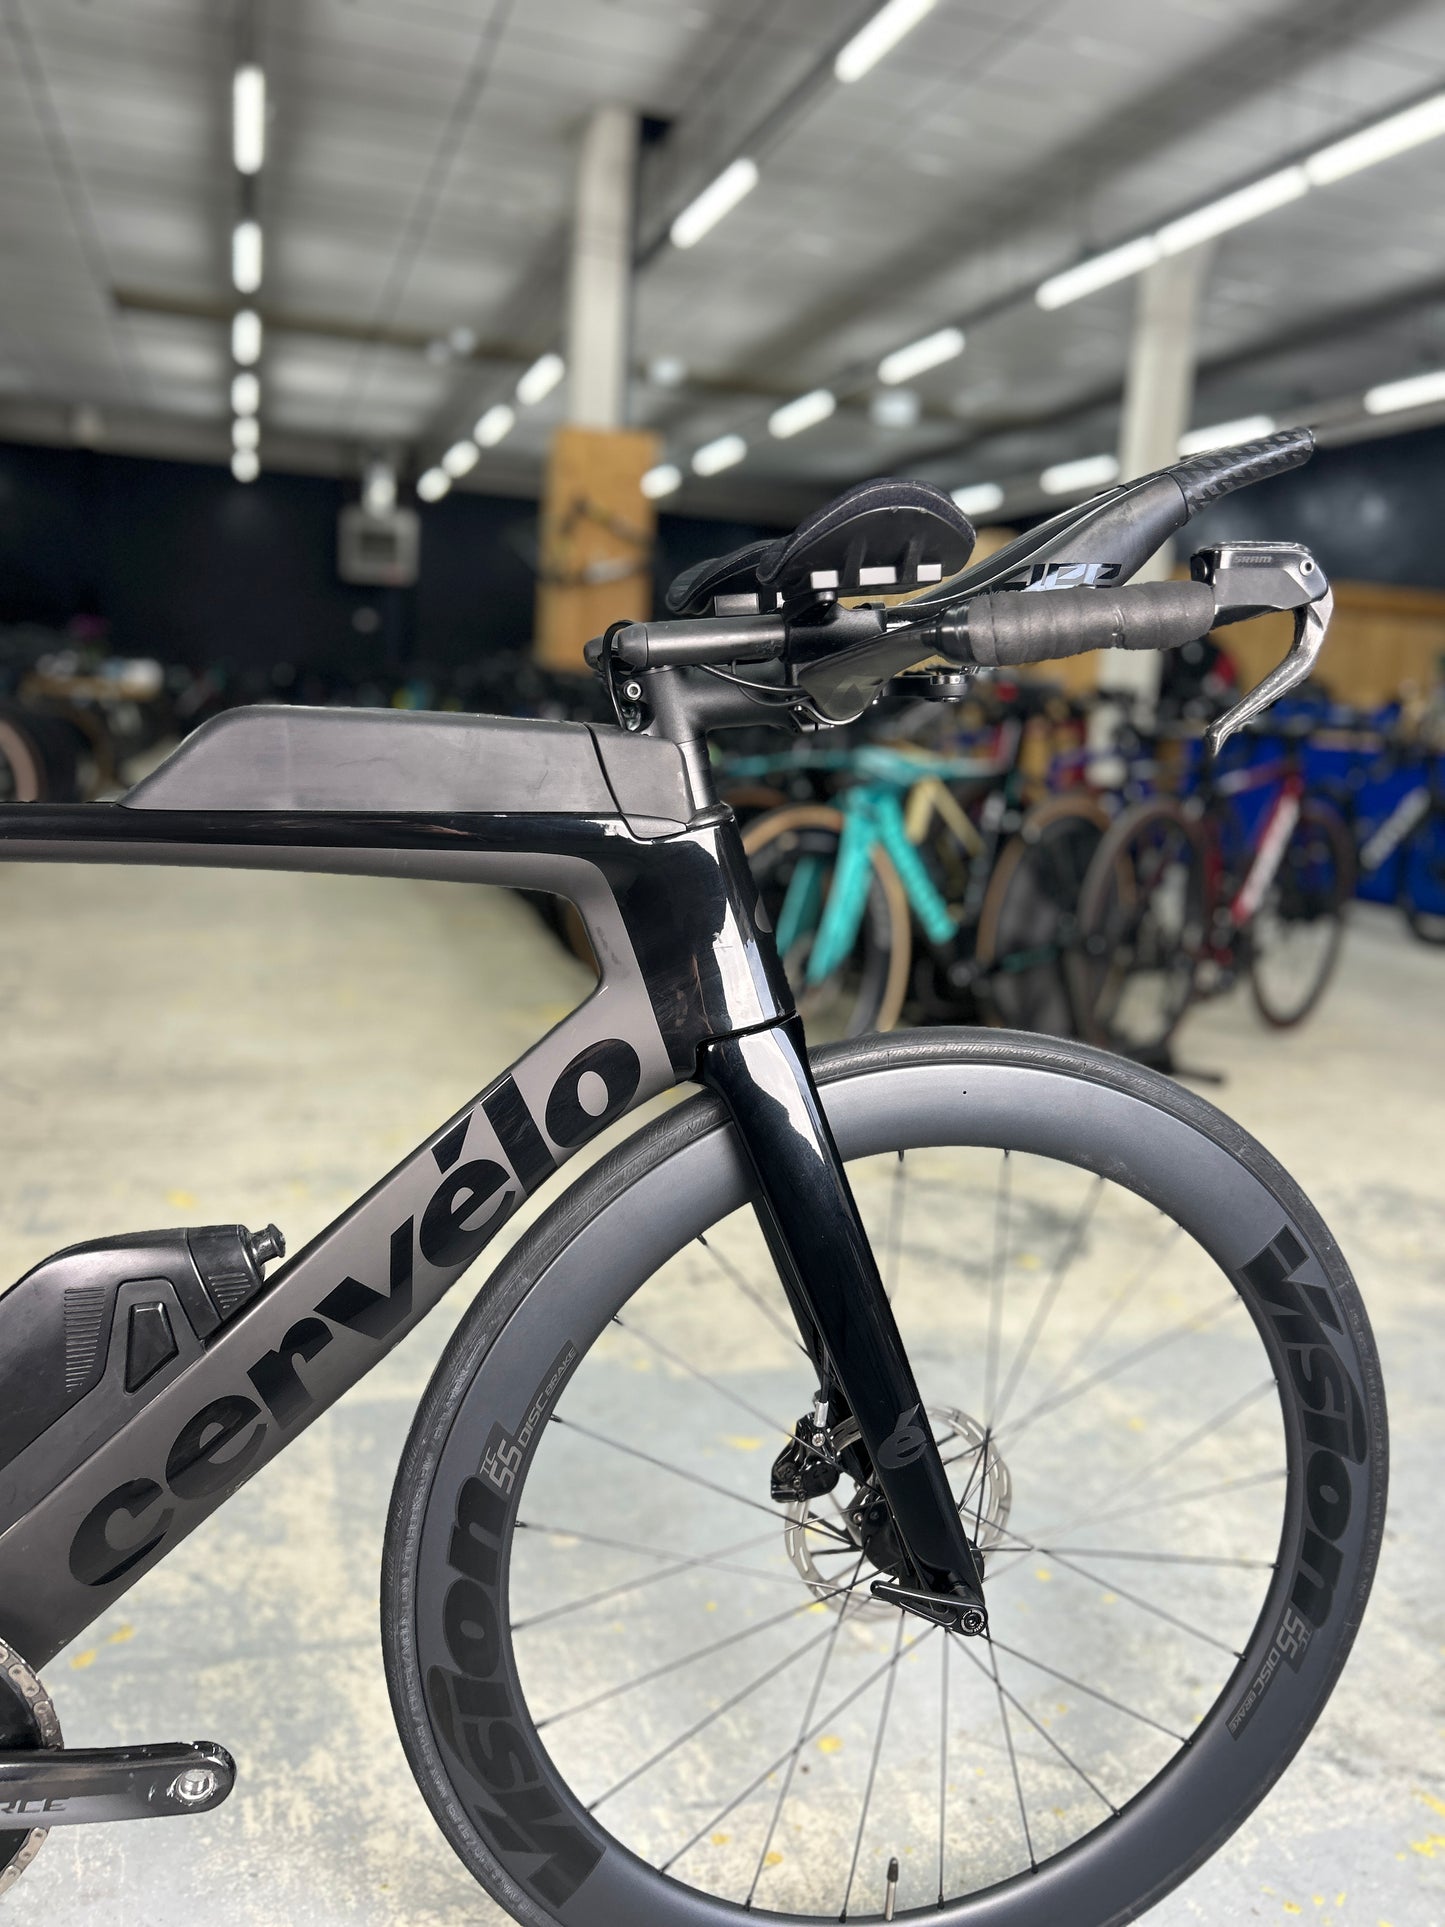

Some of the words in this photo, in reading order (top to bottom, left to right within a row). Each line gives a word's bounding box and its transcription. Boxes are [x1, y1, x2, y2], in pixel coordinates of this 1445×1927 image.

[1233, 555, 1272, 563] SRAM
[487, 1439, 524, 1494] 55
[517, 1391, 548, 1447] DISC
[545, 1345, 576, 1396] BRAKE
[479, 1446, 496, 1474] TC
[1273, 1607, 1306, 1658] 55
[1252, 1646, 1280, 1696] DISC
[1227, 1690, 1256, 1733] BRAKE
